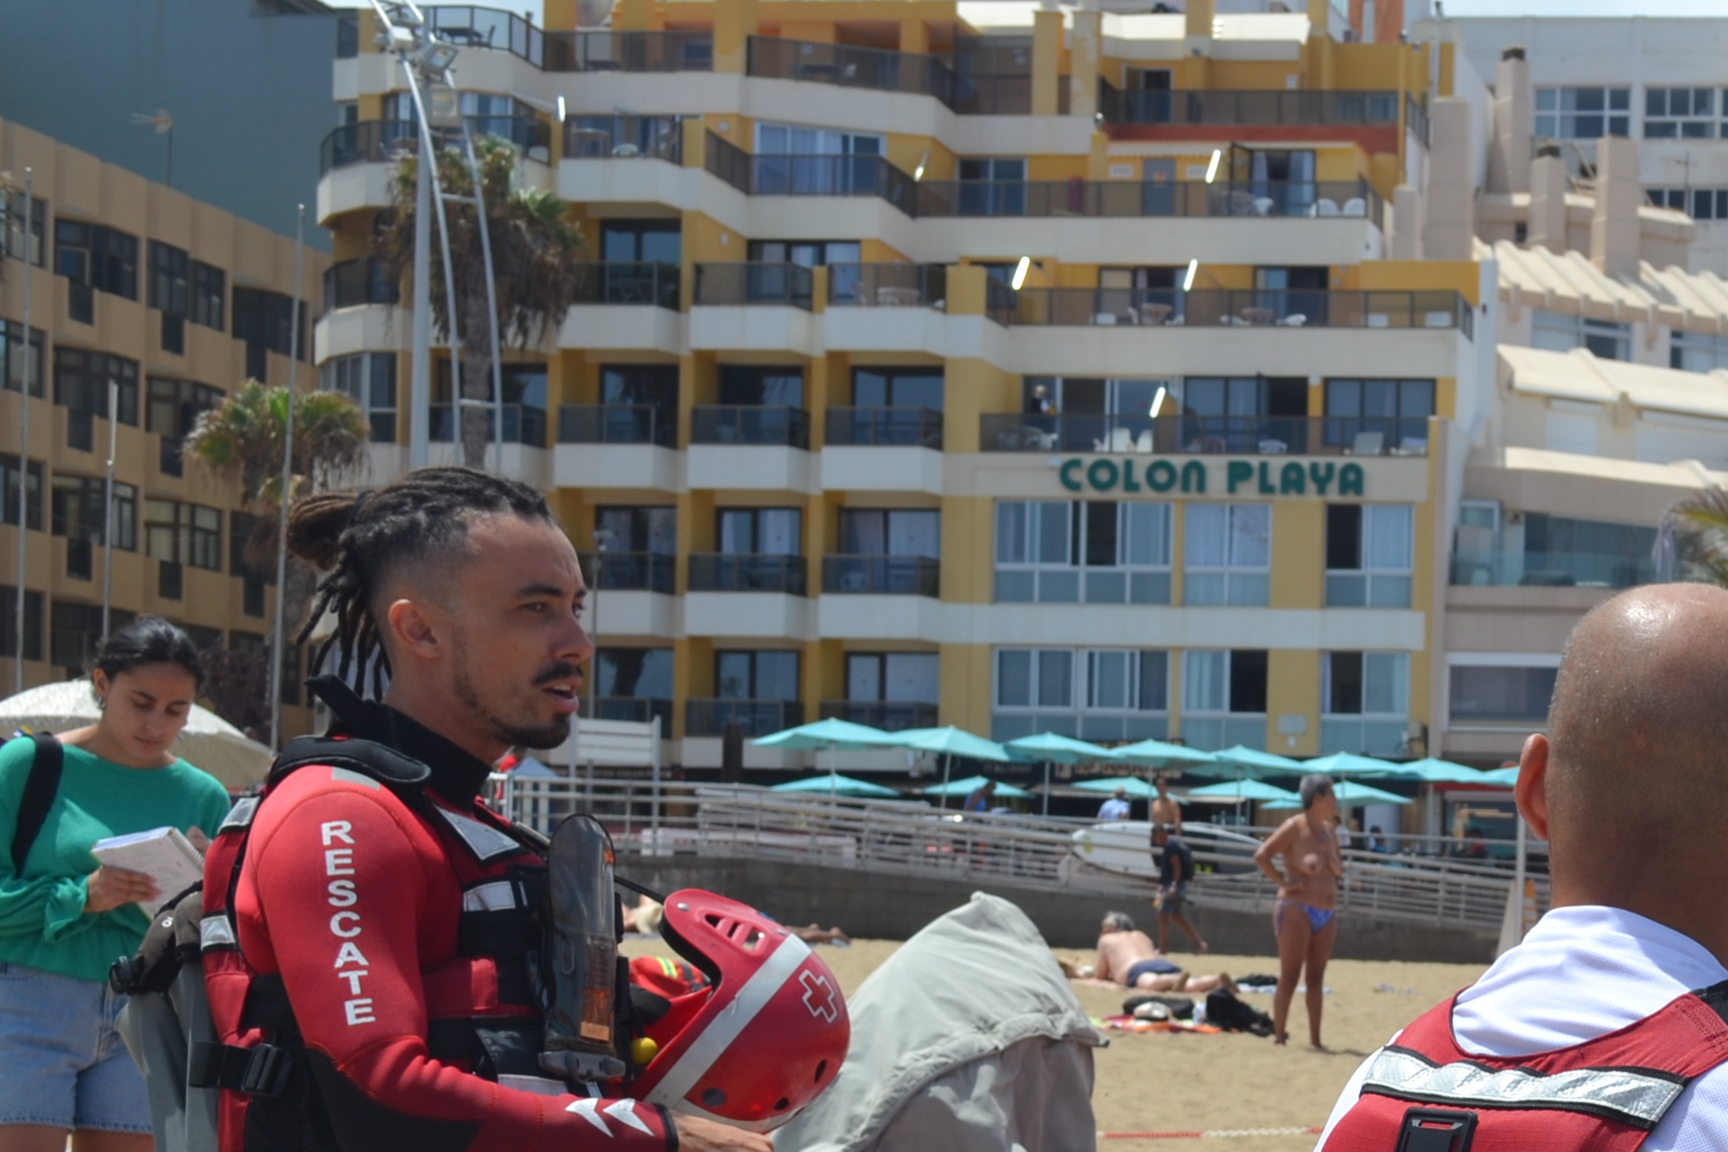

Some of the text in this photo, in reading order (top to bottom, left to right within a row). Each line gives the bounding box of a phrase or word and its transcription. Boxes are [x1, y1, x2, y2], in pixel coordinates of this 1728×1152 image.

[1060, 458, 1364, 495] COLON PLAYA
[320, 820, 377, 1026] RESCATE
